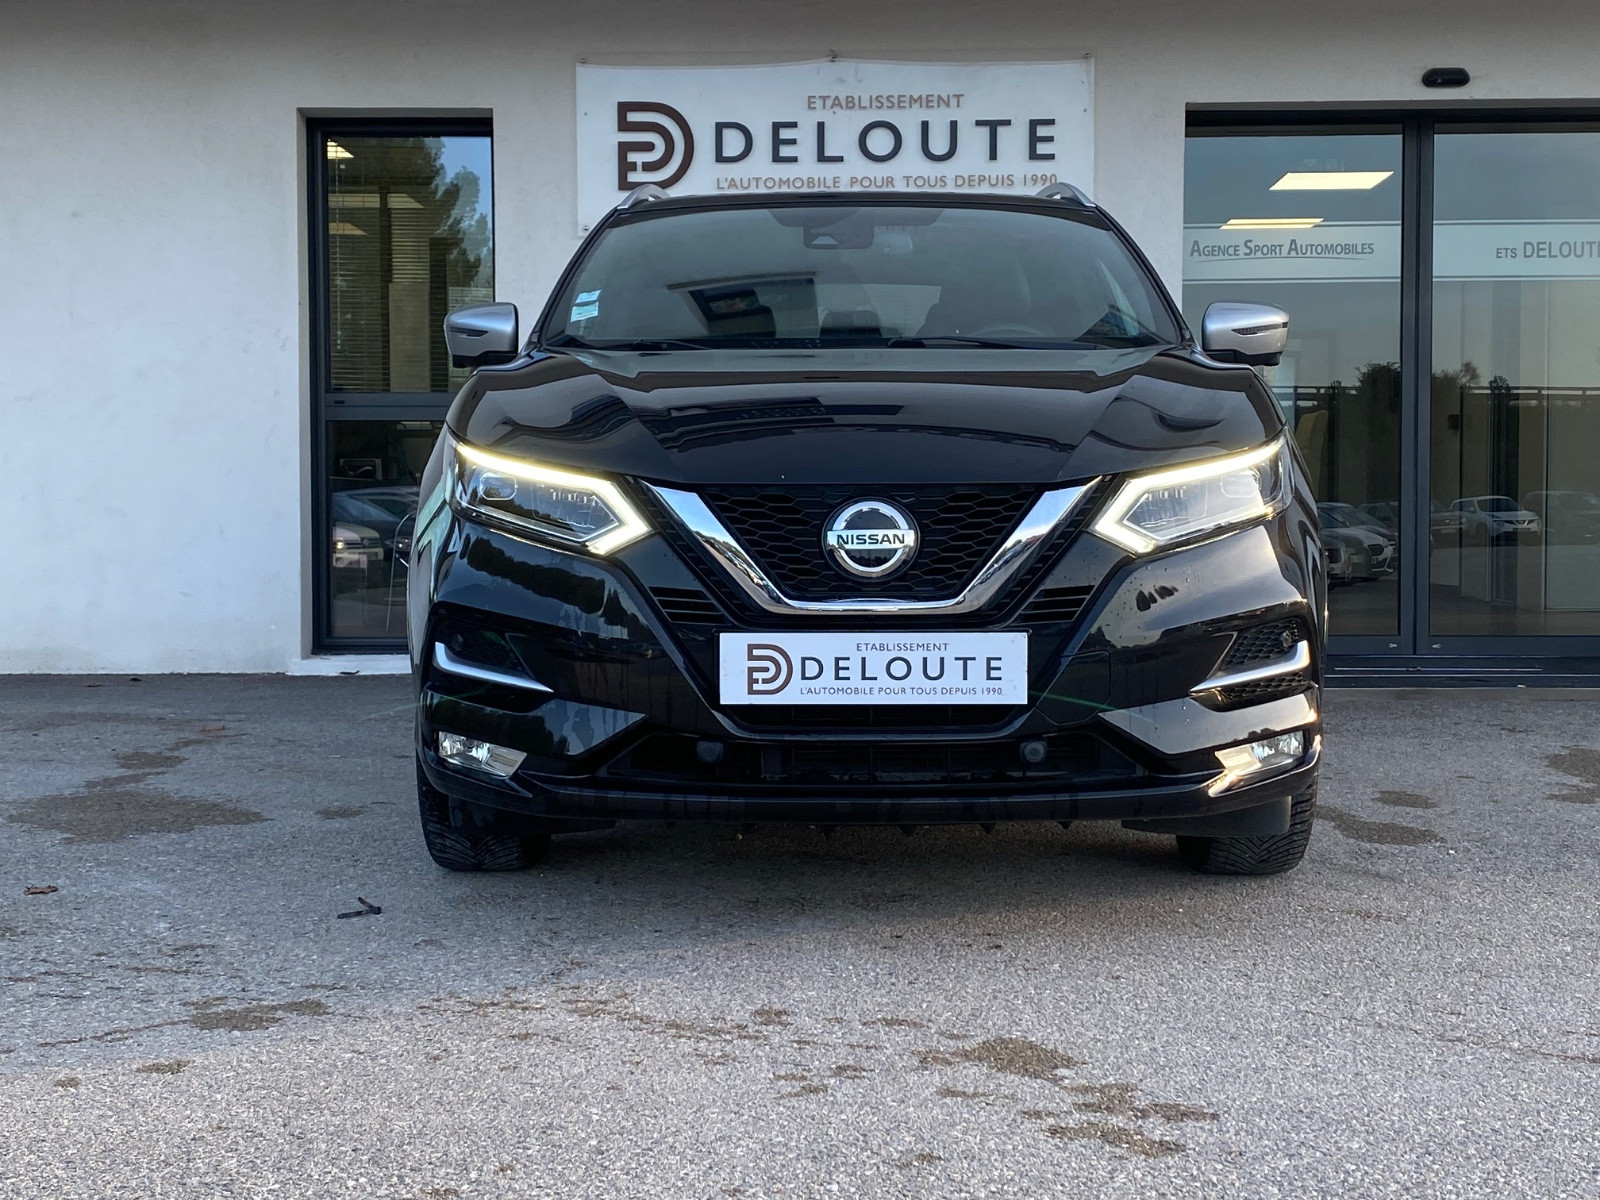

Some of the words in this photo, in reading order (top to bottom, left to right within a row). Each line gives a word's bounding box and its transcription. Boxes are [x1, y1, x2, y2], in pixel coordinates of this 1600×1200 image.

[806, 93, 965, 110] ETABLISSEMENT
[714, 117, 1057, 163] DELOUTE
[716, 176, 841, 190] L'AUTOMOBILE
[849, 175, 896, 189] POUR
[903, 175, 948, 189] TOUS
[953, 174, 1015, 188] DEPUIS
[1023, 173, 1058, 187] 1990
[1495, 247, 1518, 259] ETS
[1523, 240, 1600, 259] DELOUT
[836, 533, 905, 545] NISSAN
[856, 642, 949, 652] ETABLISSEMENT
[800, 656, 1003, 681] DELOUTE
[800, 686, 875, 696] L'AUTOMOBILE
[878, 686, 907, 696] POUR
[910, 686, 938, 696] TOUS
[941, 686, 977, 696] DEPUIS
[981, 686, 1002, 696] 1990
